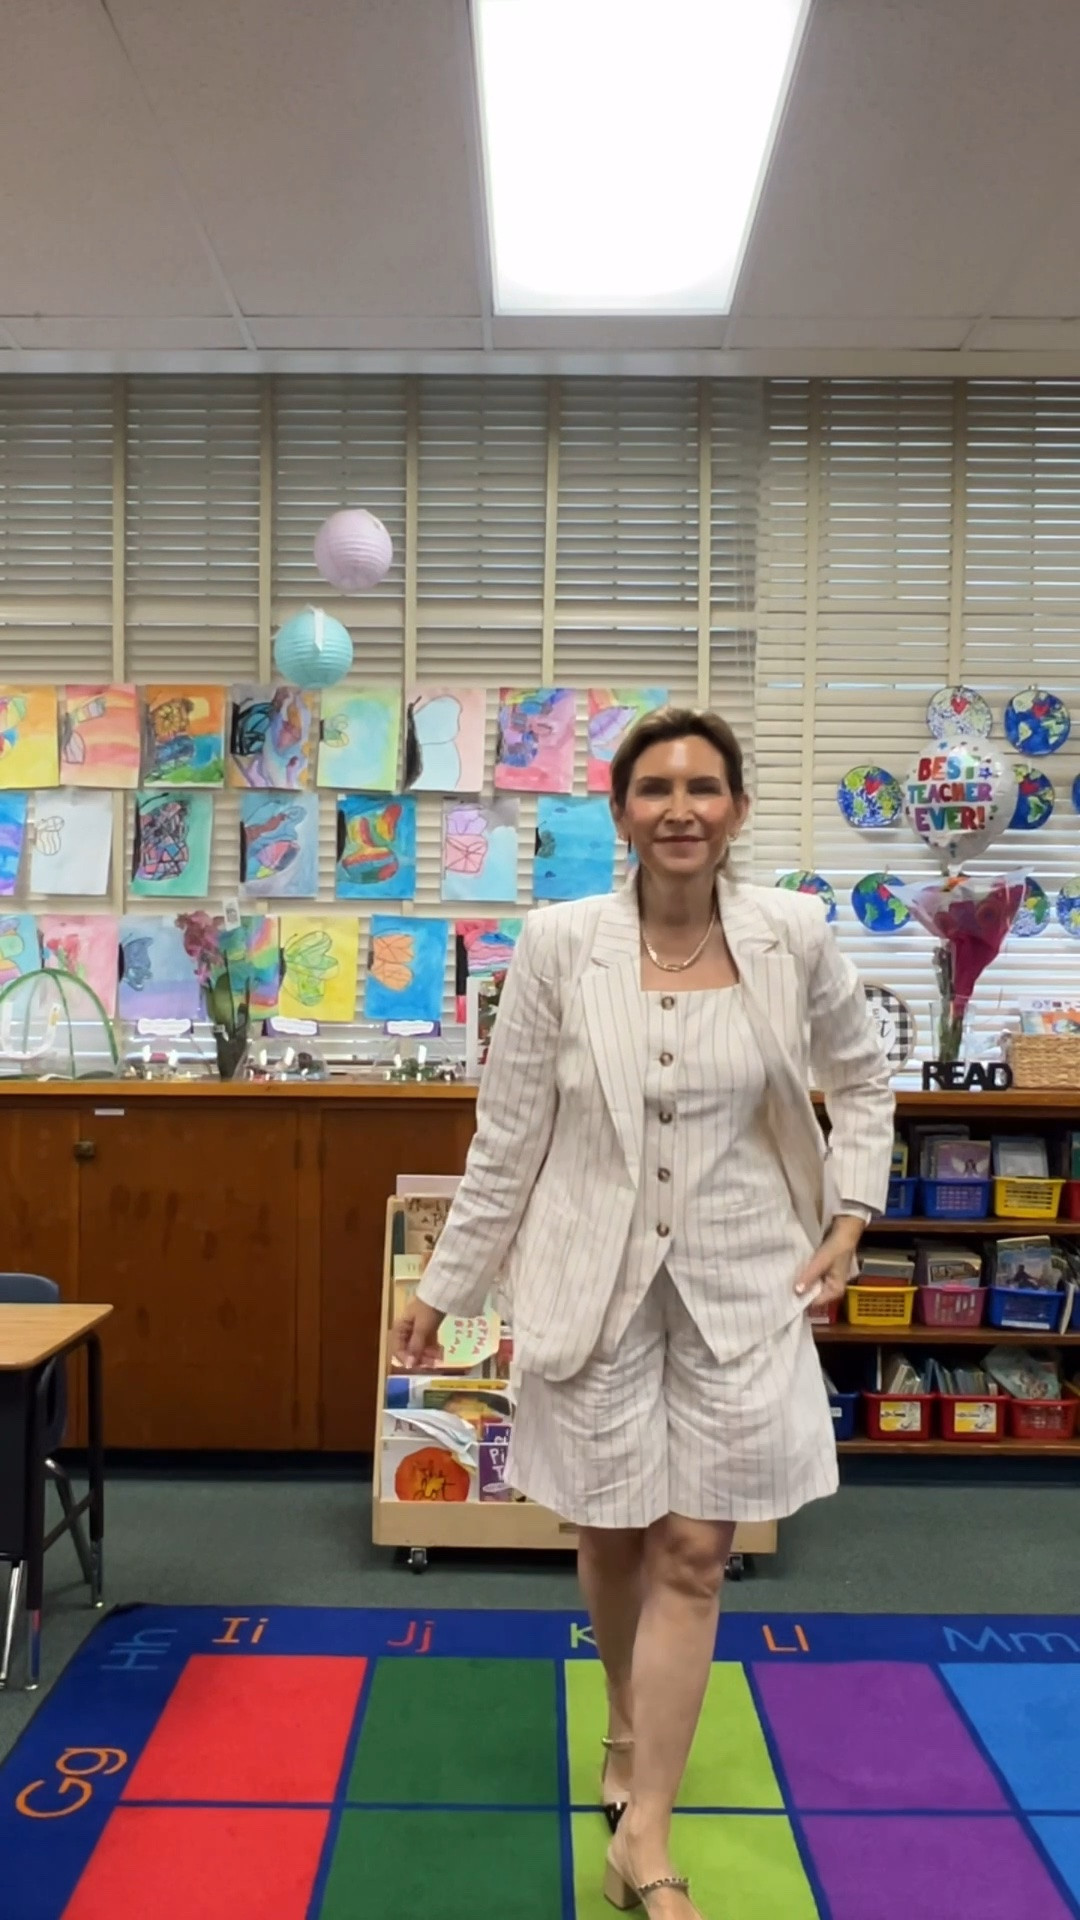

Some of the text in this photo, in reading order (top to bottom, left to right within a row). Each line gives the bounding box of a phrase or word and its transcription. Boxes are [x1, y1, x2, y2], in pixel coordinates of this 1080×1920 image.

[917, 755, 981, 782] BEST
[907, 783, 993, 804] TEACHER
[915, 806, 986, 832] EVER!
[922, 1061, 1013, 1091] READ
[211, 1617, 269, 1644] Ii
[387, 1621, 435, 1653] Jj
[571, 1623, 597, 1648] K
[942, 1626, 1080, 1653] Mm
[101, 1628, 178, 1670] Hh
[15, 1747, 127, 1818] Gg
